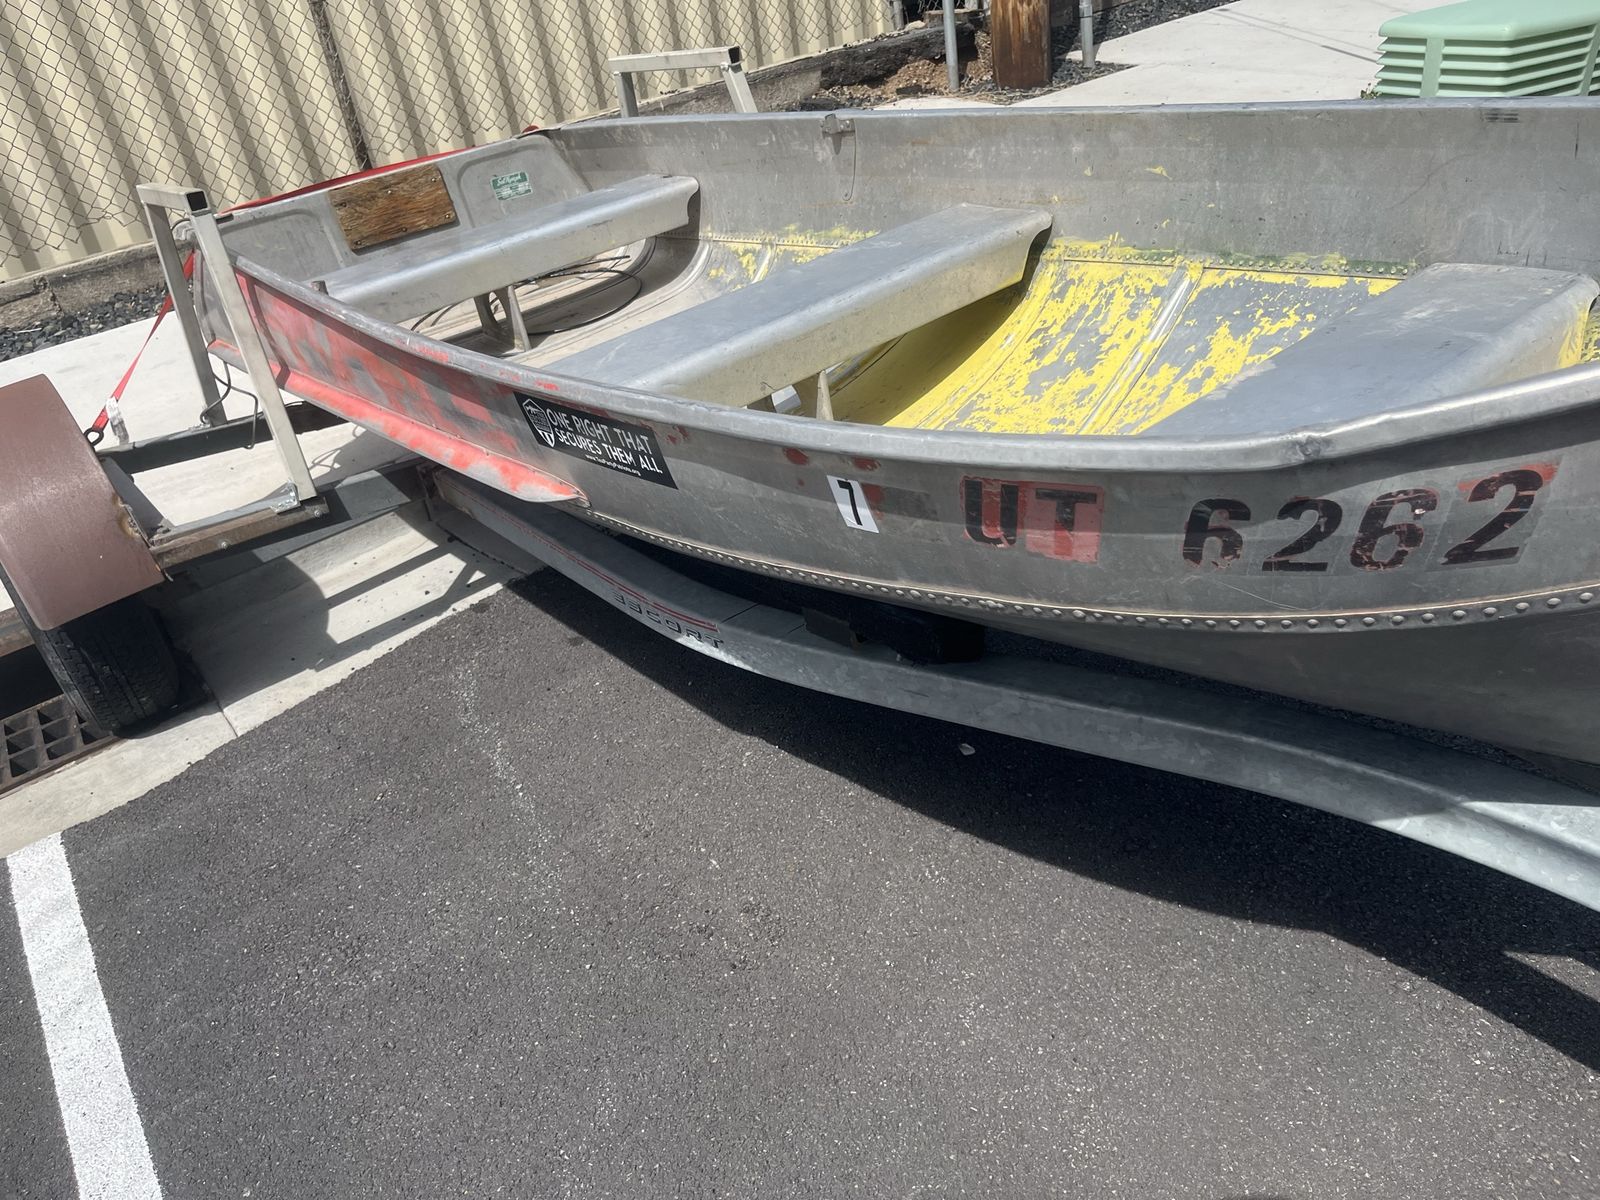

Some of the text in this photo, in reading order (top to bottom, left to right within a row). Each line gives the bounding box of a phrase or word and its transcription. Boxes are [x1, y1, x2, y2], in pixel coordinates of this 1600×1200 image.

[546, 408, 574, 431] ONE
[572, 414, 613, 443] RIGHT
[613, 427, 653, 455] THAT
[554, 427, 663, 474] SECURES THEM ALL
[964, 469, 1544, 572] UT 6262
